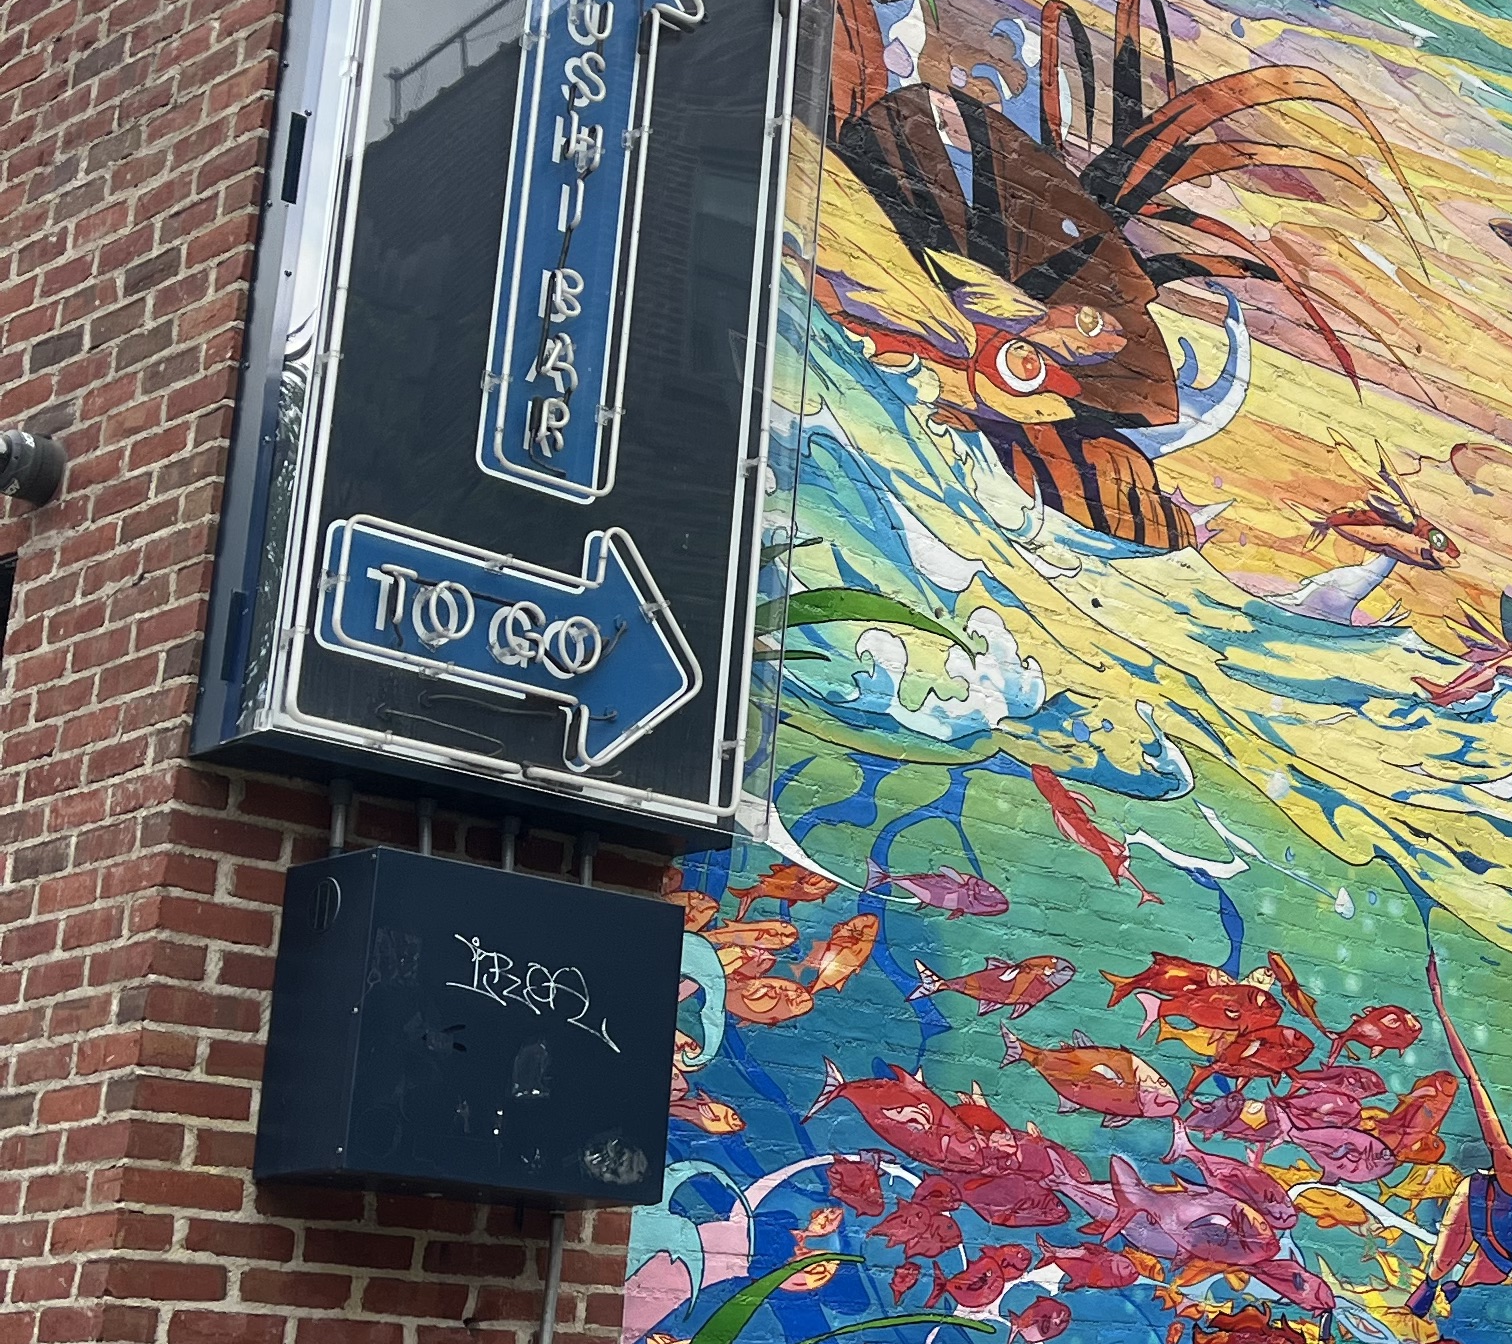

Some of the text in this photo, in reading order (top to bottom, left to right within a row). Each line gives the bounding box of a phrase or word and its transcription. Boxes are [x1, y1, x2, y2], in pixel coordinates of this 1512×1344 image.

[523, 268, 584, 458] BAR
[366, 563, 602, 679] TO GO
